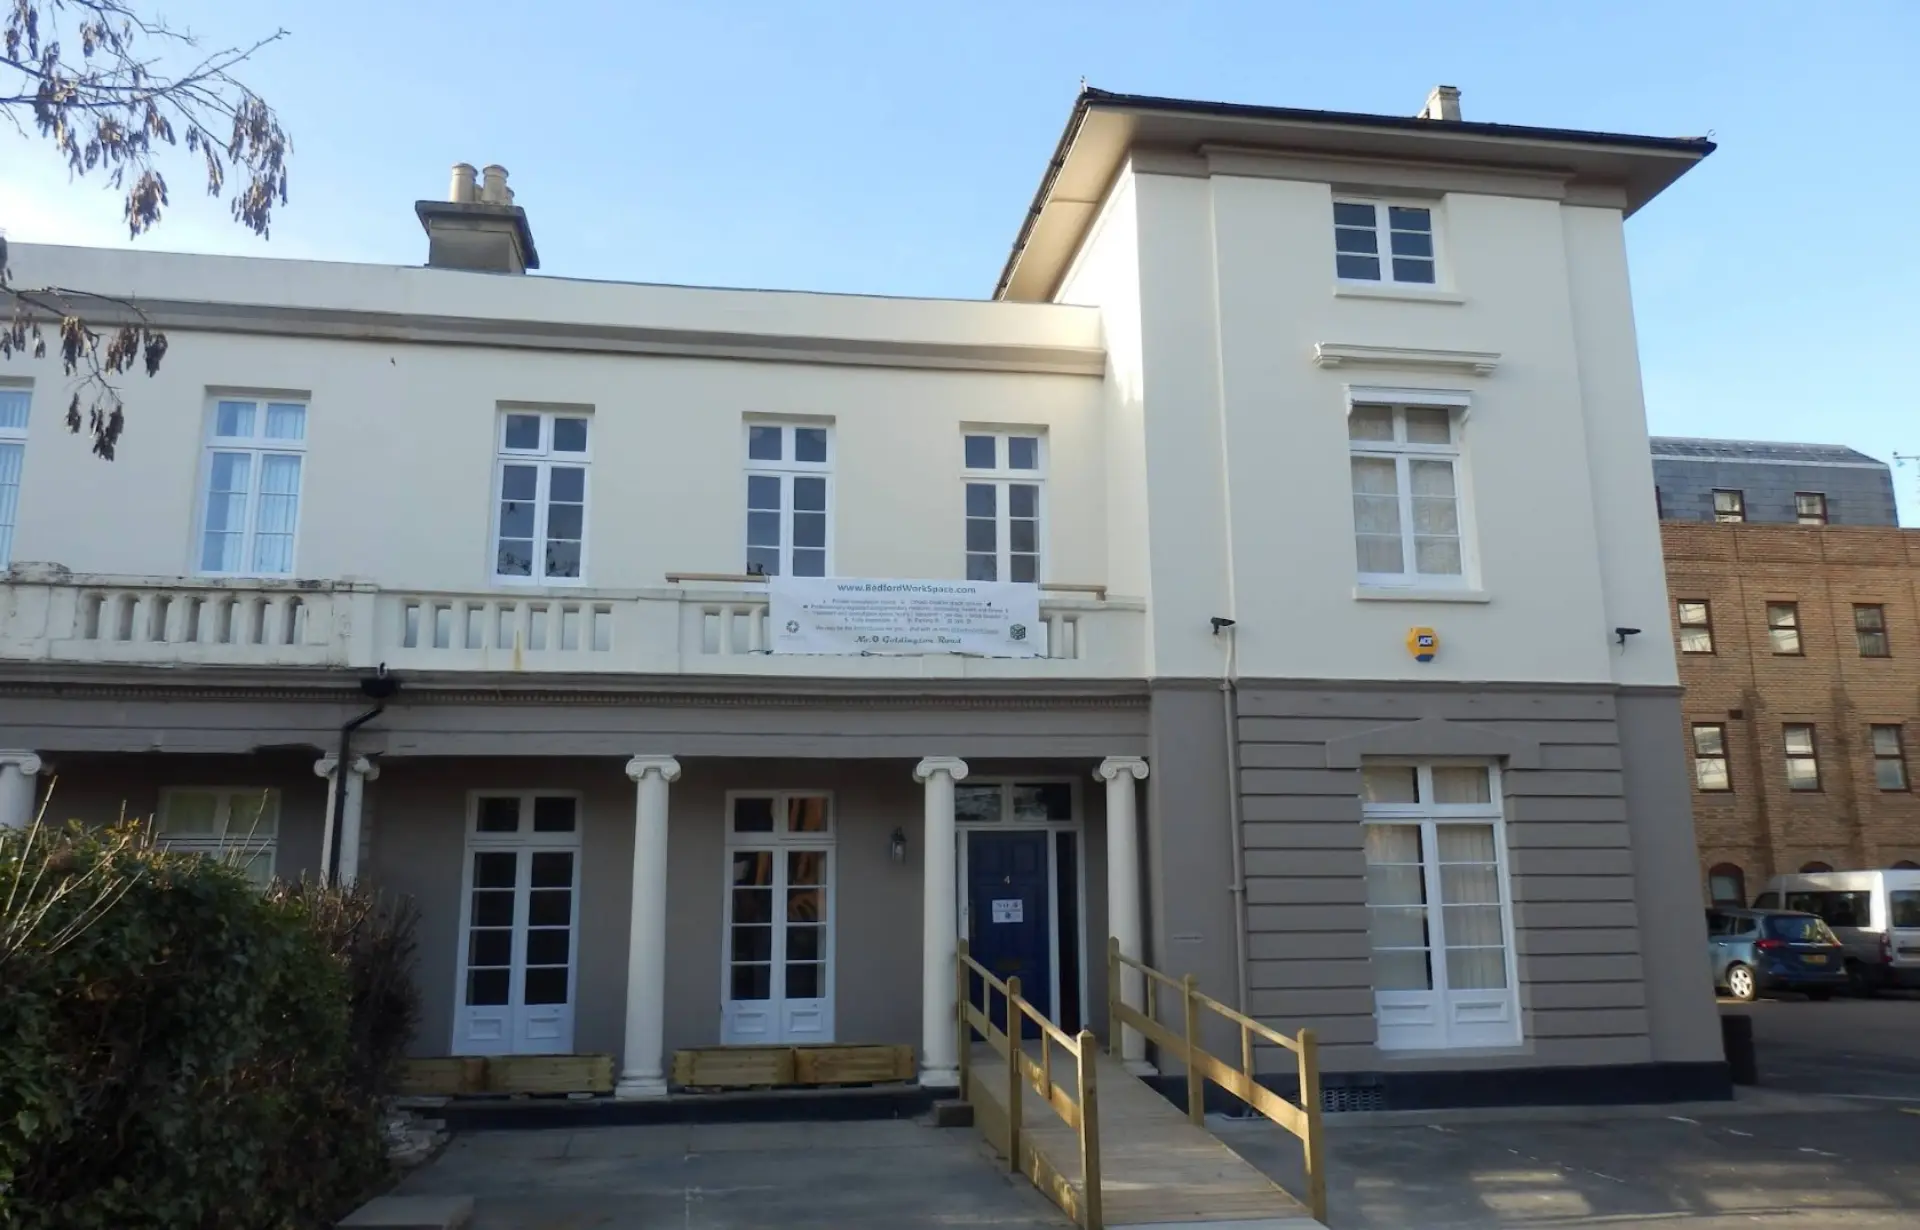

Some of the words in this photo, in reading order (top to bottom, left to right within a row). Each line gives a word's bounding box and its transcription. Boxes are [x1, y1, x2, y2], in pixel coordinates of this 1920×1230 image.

[837, 584, 976, 594] www.BedfordWorkSpace.com
[937, 635, 962, 644] Road
[1004, 876, 1010, 884] 4
